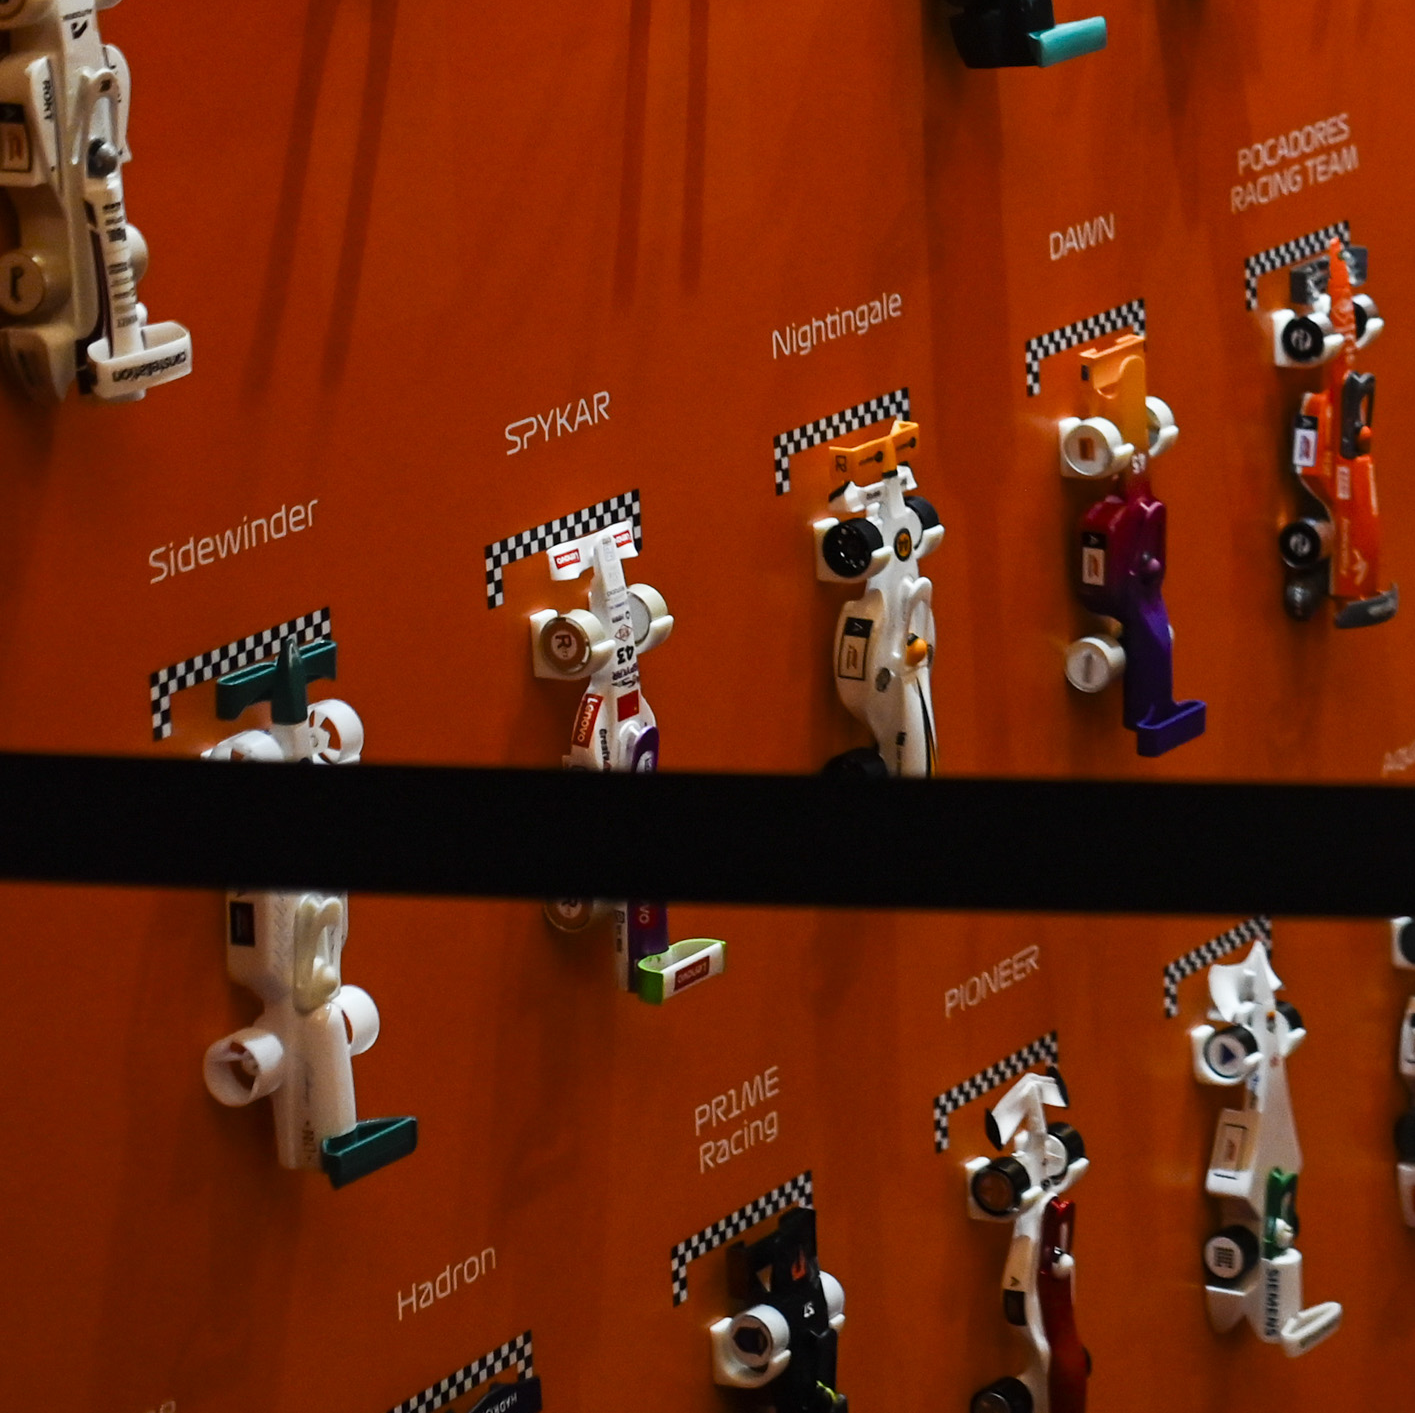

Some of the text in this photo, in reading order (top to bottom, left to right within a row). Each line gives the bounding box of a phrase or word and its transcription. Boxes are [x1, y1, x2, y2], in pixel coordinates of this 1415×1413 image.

[1237, 114, 1350, 177] POCADORES
[1230, 146, 1359, 214] RACING TEAM
[1050, 215, 1114, 260] DAWN
[772, 293, 901, 359] Nightingale
[505, 391, 609, 455] SPYKAR
[149, 500, 318, 584] Sidewinder
[576, 696, 599, 744] Lenovo
[945, 945, 1039, 1017] PIONEER
[699, 1109, 780, 1174] Racing
[398, 1248, 495, 1320] Hadron
[1265, 1268, 1281, 1337] SIEMENS
